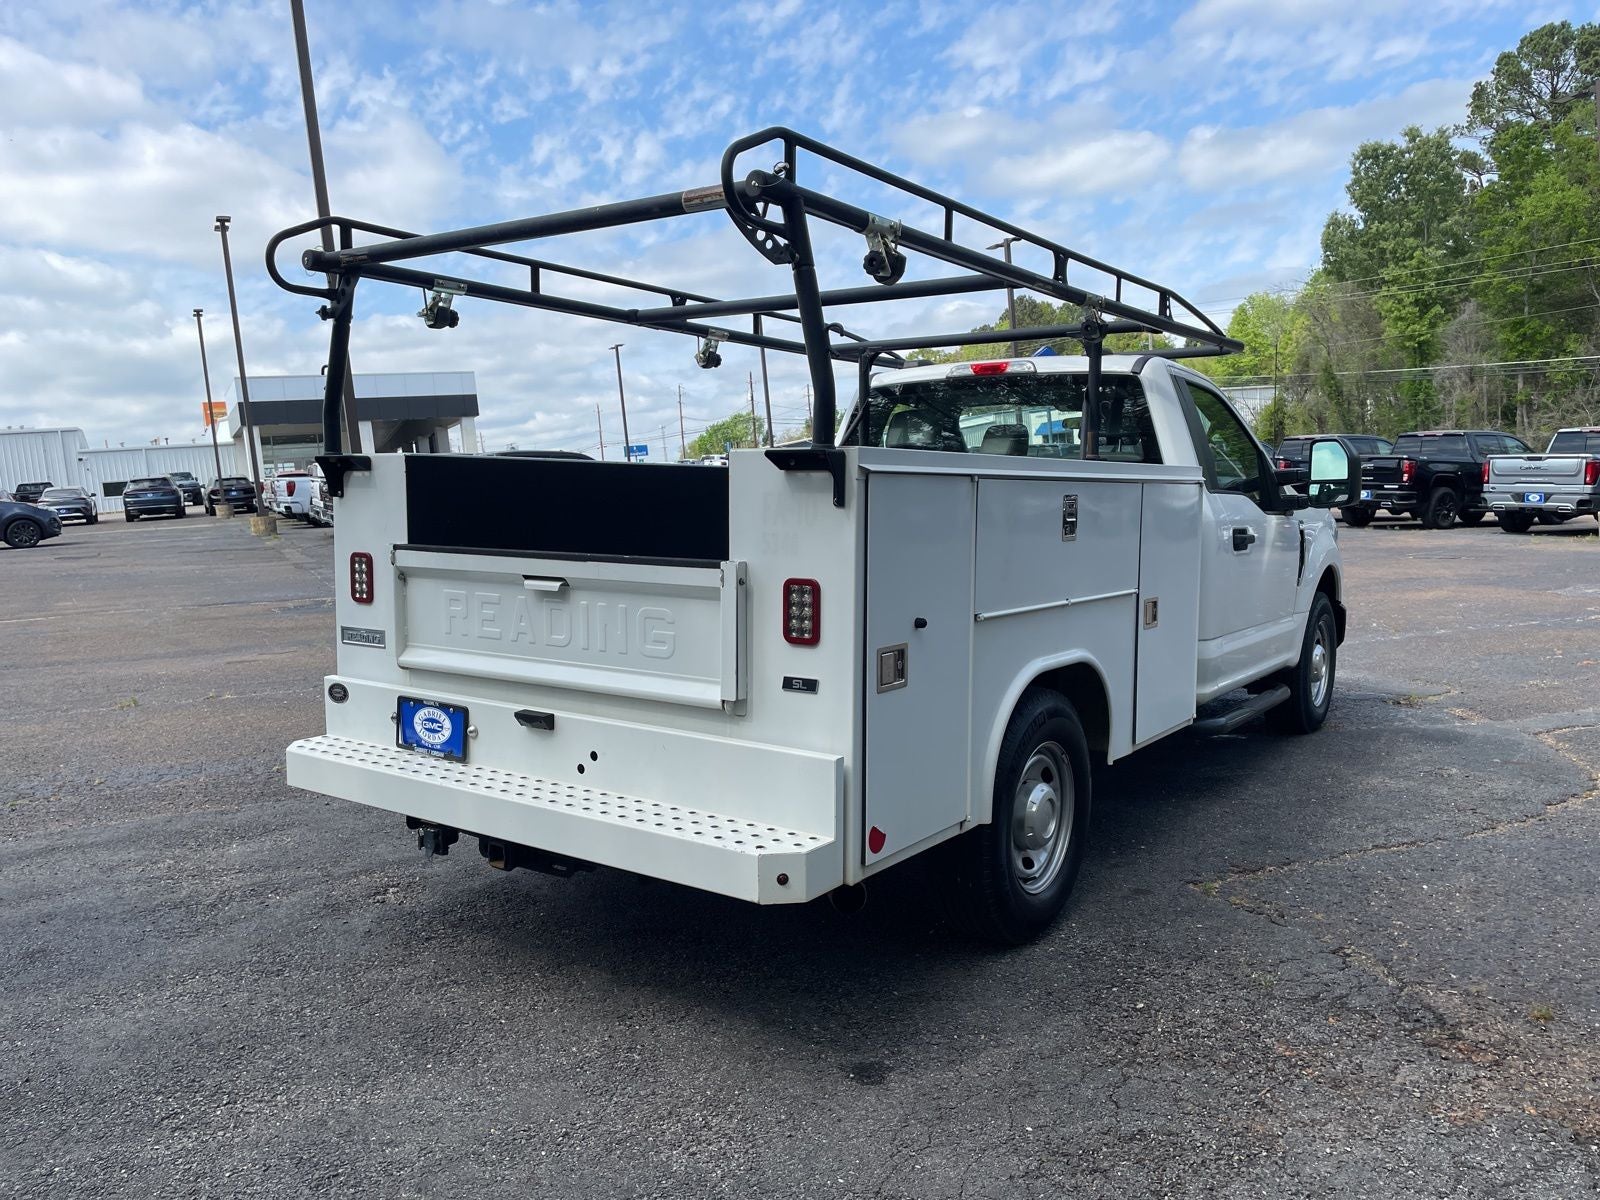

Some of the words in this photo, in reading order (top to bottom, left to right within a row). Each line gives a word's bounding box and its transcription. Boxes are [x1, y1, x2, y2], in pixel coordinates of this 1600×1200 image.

[442, 589, 676, 660] READING
[792, 679, 807, 690] SL
[422, 720, 443, 731] GMC
[419, 728, 446, 741] JORDAN
